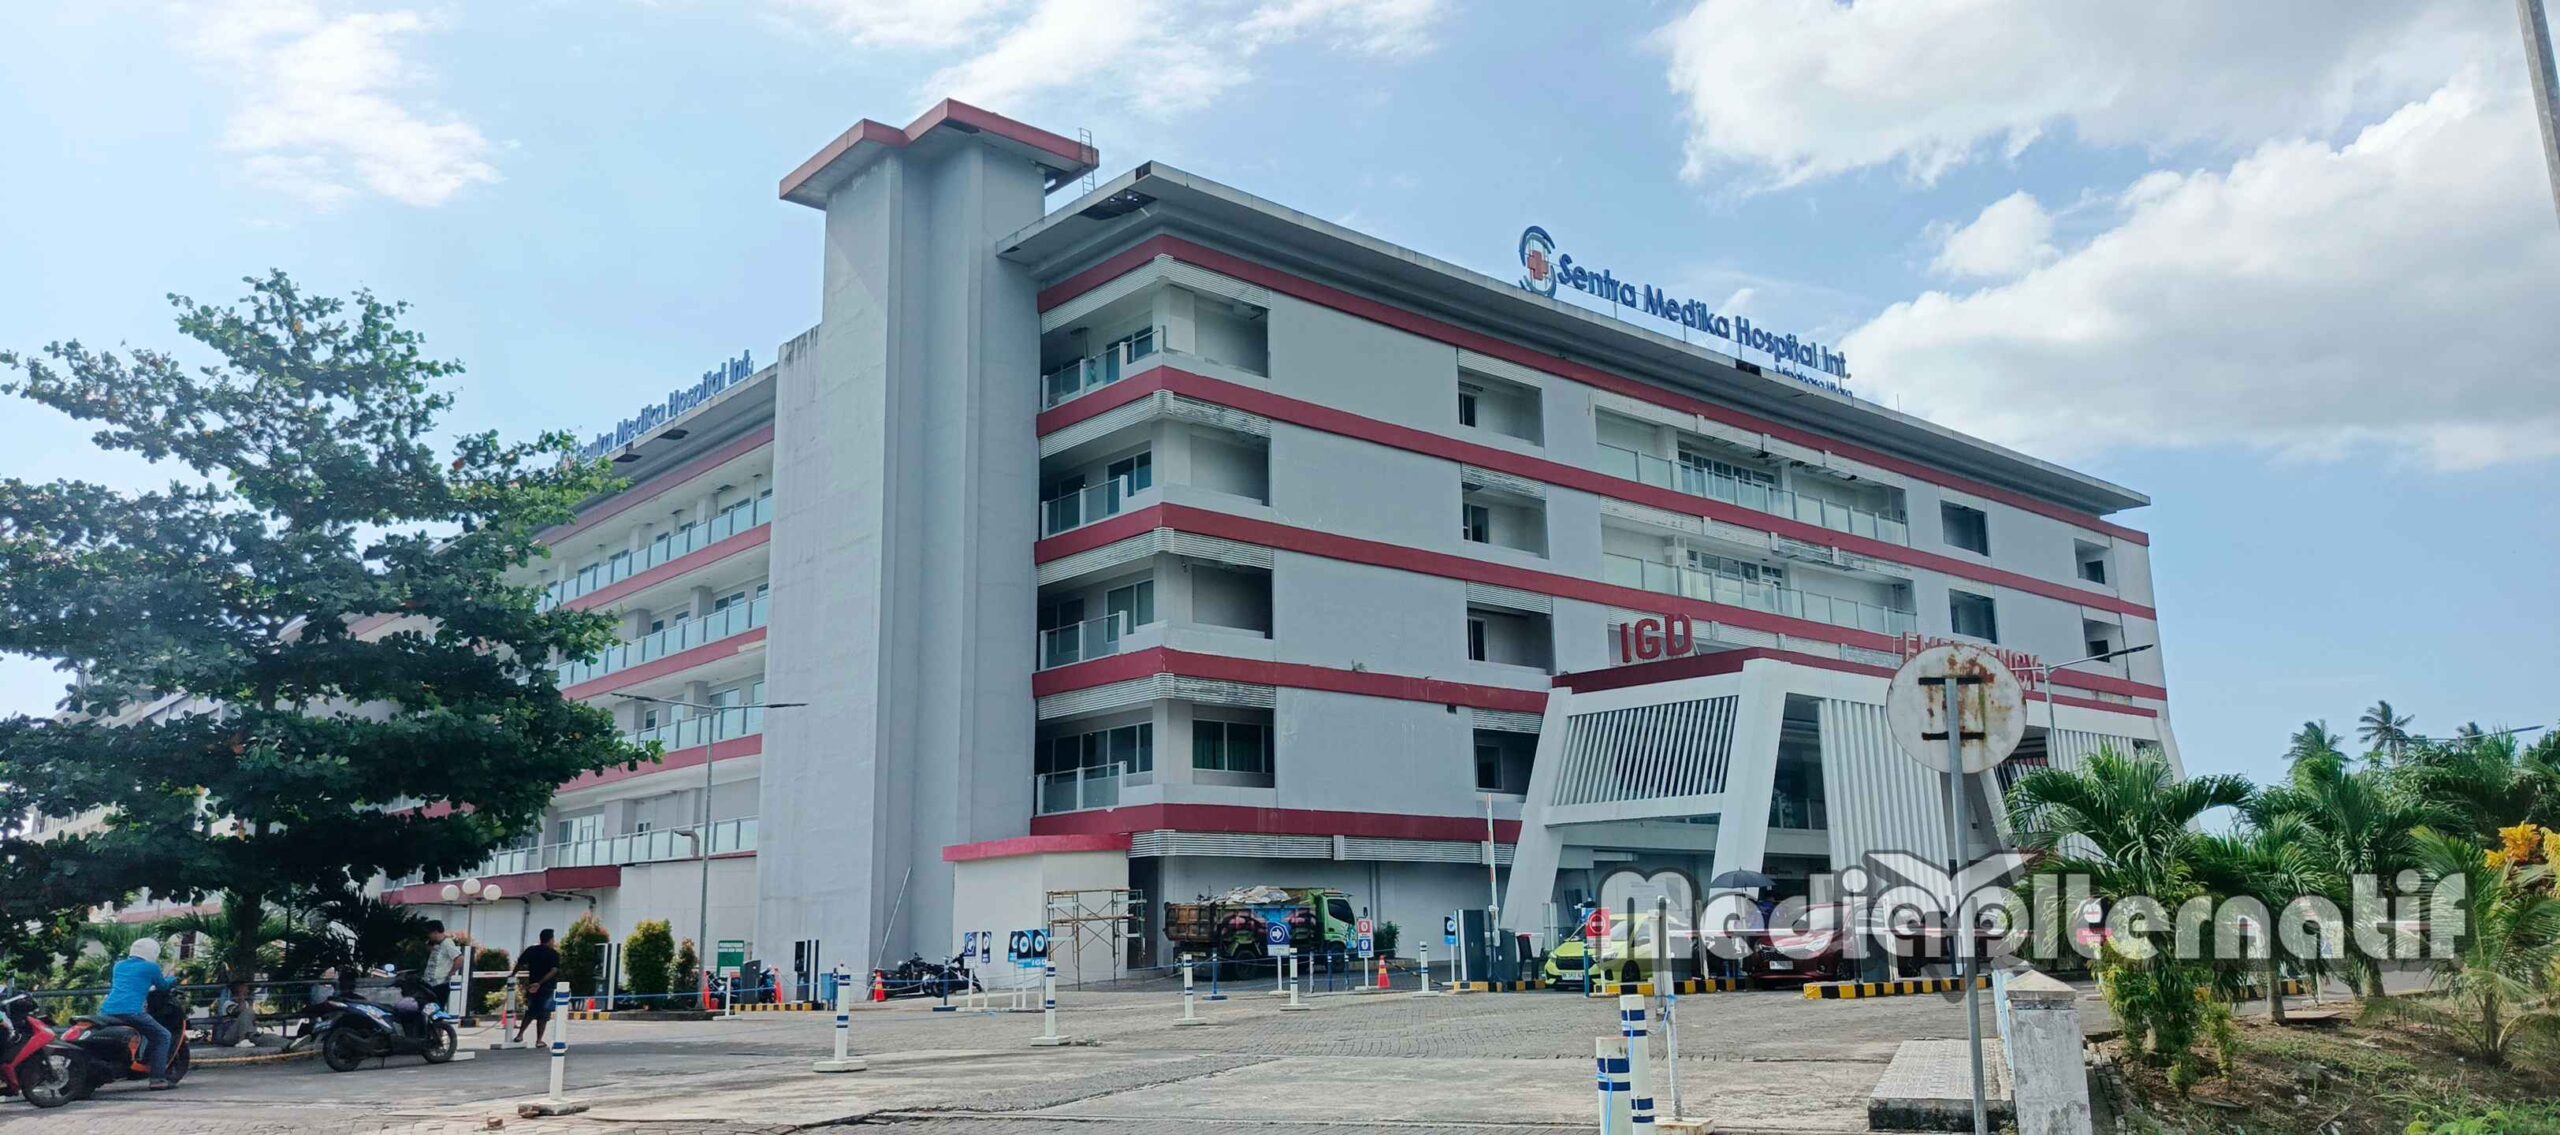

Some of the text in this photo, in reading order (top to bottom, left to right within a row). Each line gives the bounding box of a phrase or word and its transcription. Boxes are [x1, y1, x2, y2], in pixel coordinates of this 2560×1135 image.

[1558, 253, 1852, 379] Sentra Medika Hospital Int.
[616, 403, 666, 446] Medika
[669, 362, 727, 417] Hospital
[1620, 613, 1692, 664] IGD
